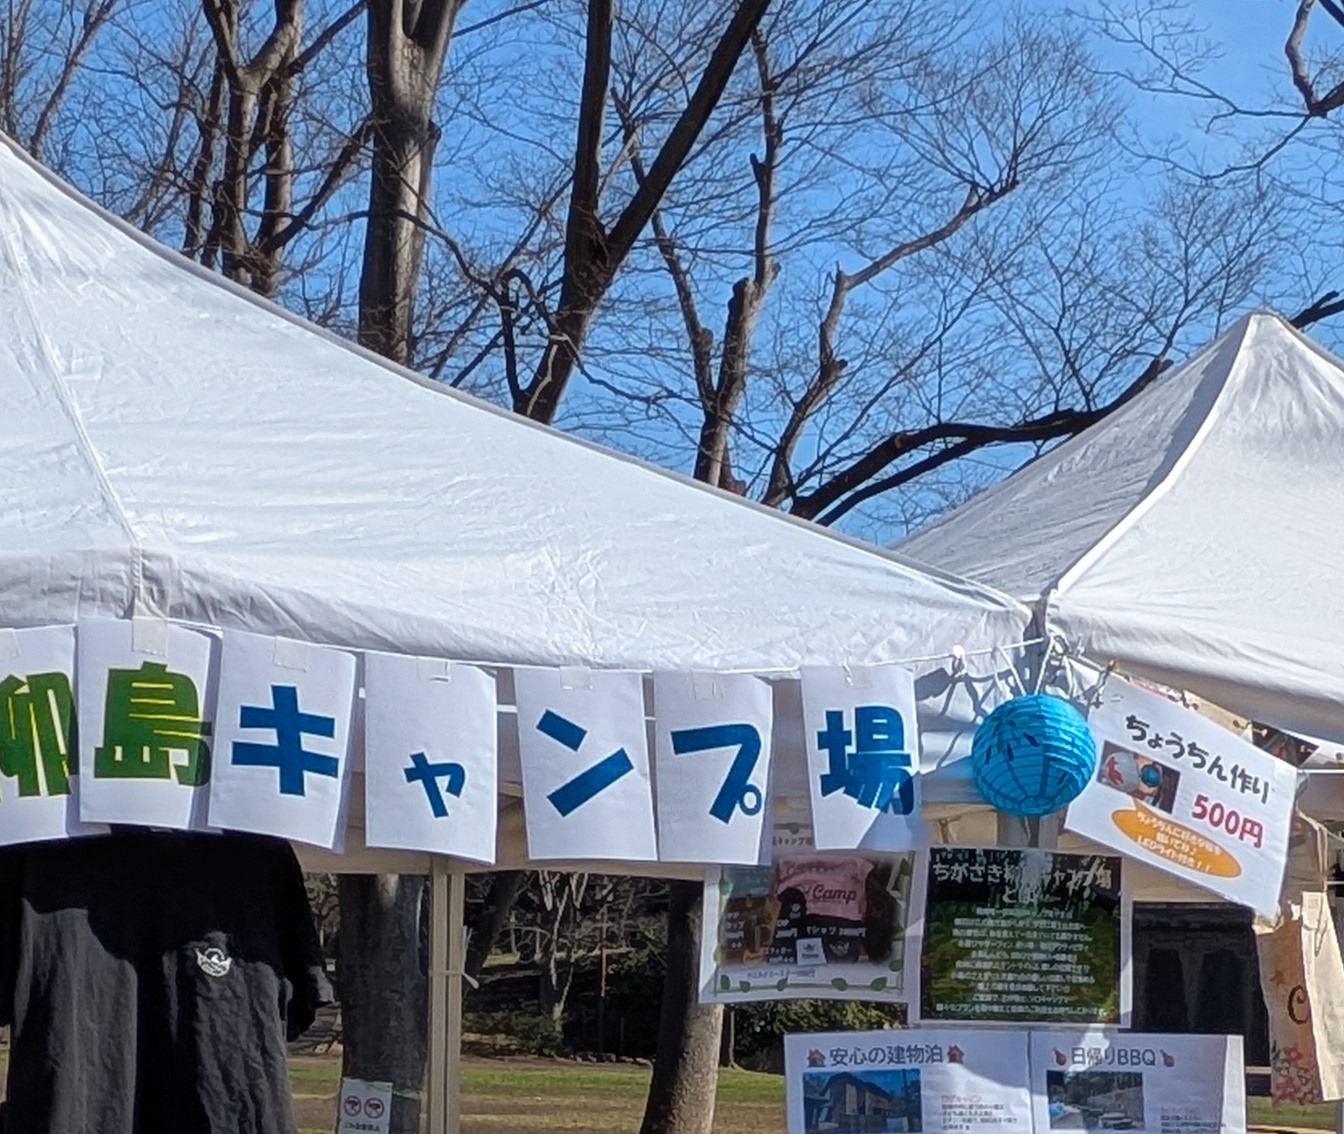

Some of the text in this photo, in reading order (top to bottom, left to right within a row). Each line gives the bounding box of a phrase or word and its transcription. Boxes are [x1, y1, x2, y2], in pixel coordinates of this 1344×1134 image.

[1125, 714, 1271, 804] ちょうちん作り
[1191, 793, 1264, 849] 500円
[829, 1044, 944, 1066] 安心の建物泊
[1071, 1047, 1156, 1067] 日帰りBBQ
